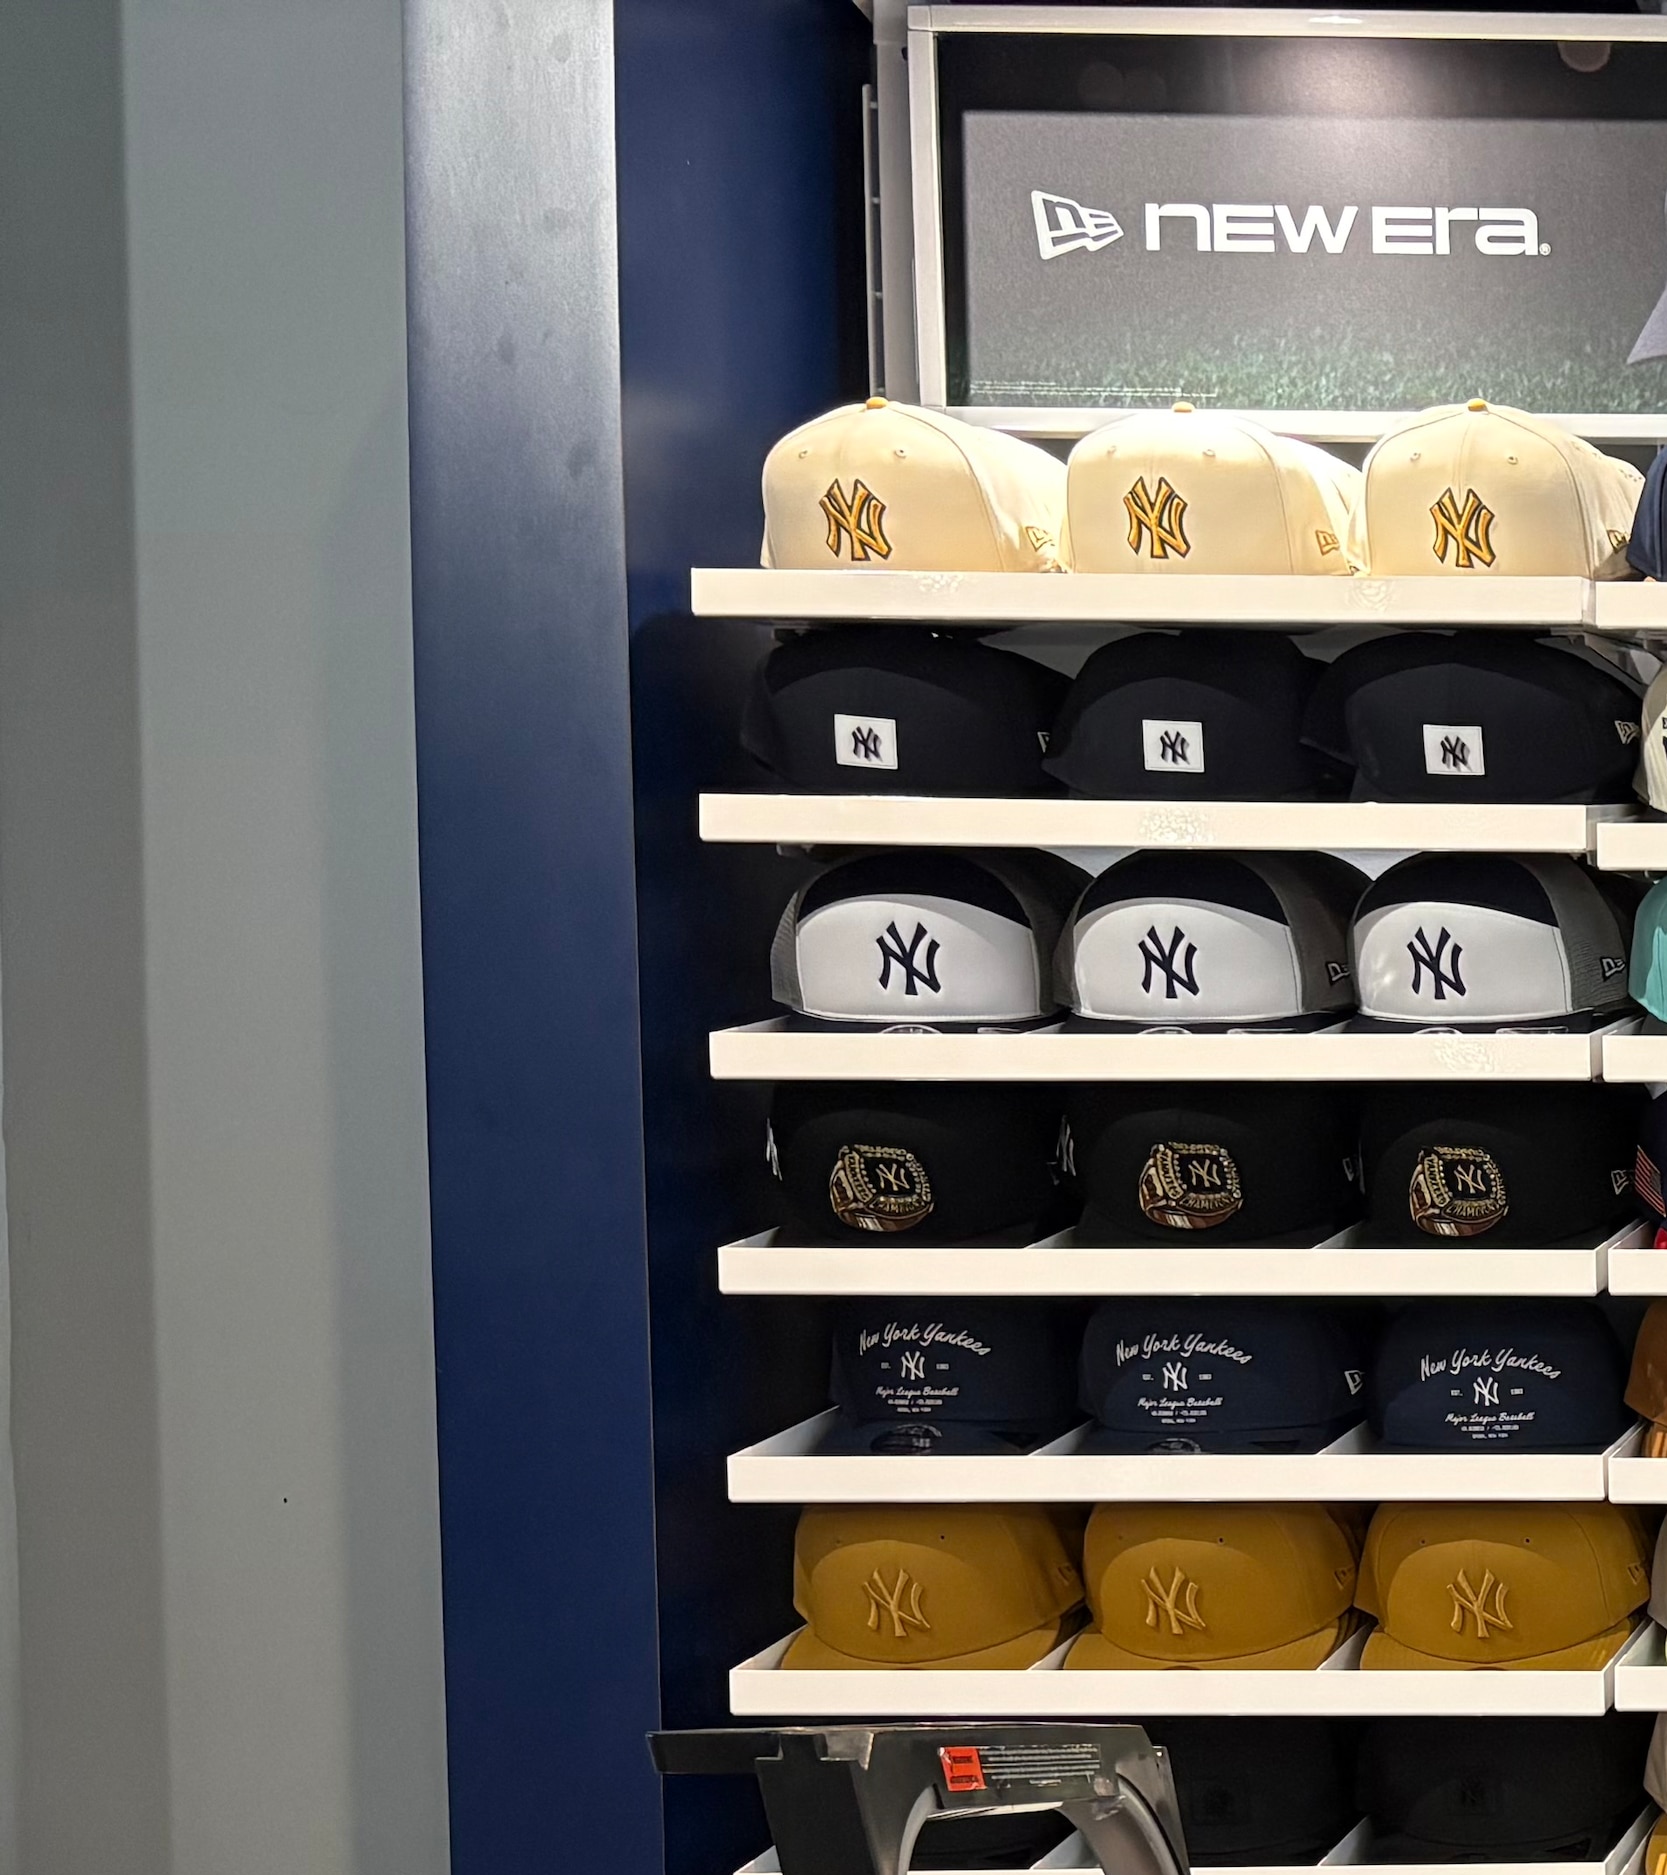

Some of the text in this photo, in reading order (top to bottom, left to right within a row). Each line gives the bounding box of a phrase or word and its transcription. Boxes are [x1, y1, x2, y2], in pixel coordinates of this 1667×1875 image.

[819, 477, 892, 562] NY
[1429, 487, 1497, 569] NY
[851, 724, 882, 762] NY
[1439, 735, 1473, 771] NY
[1137, 924, 1199, 1001] NY
[1406, 926, 1467, 1001] NY
[1188, 1159, 1221, 1188] NY
[859, 1322, 992, 1356] New York Yankees
[901, 1351, 925, 1380] NY
[1420, 1348, 1561, 1382] New York Yankees
[1473, 1376, 1500, 1407] NY
[1139, 1565, 1206, 1638] NY
